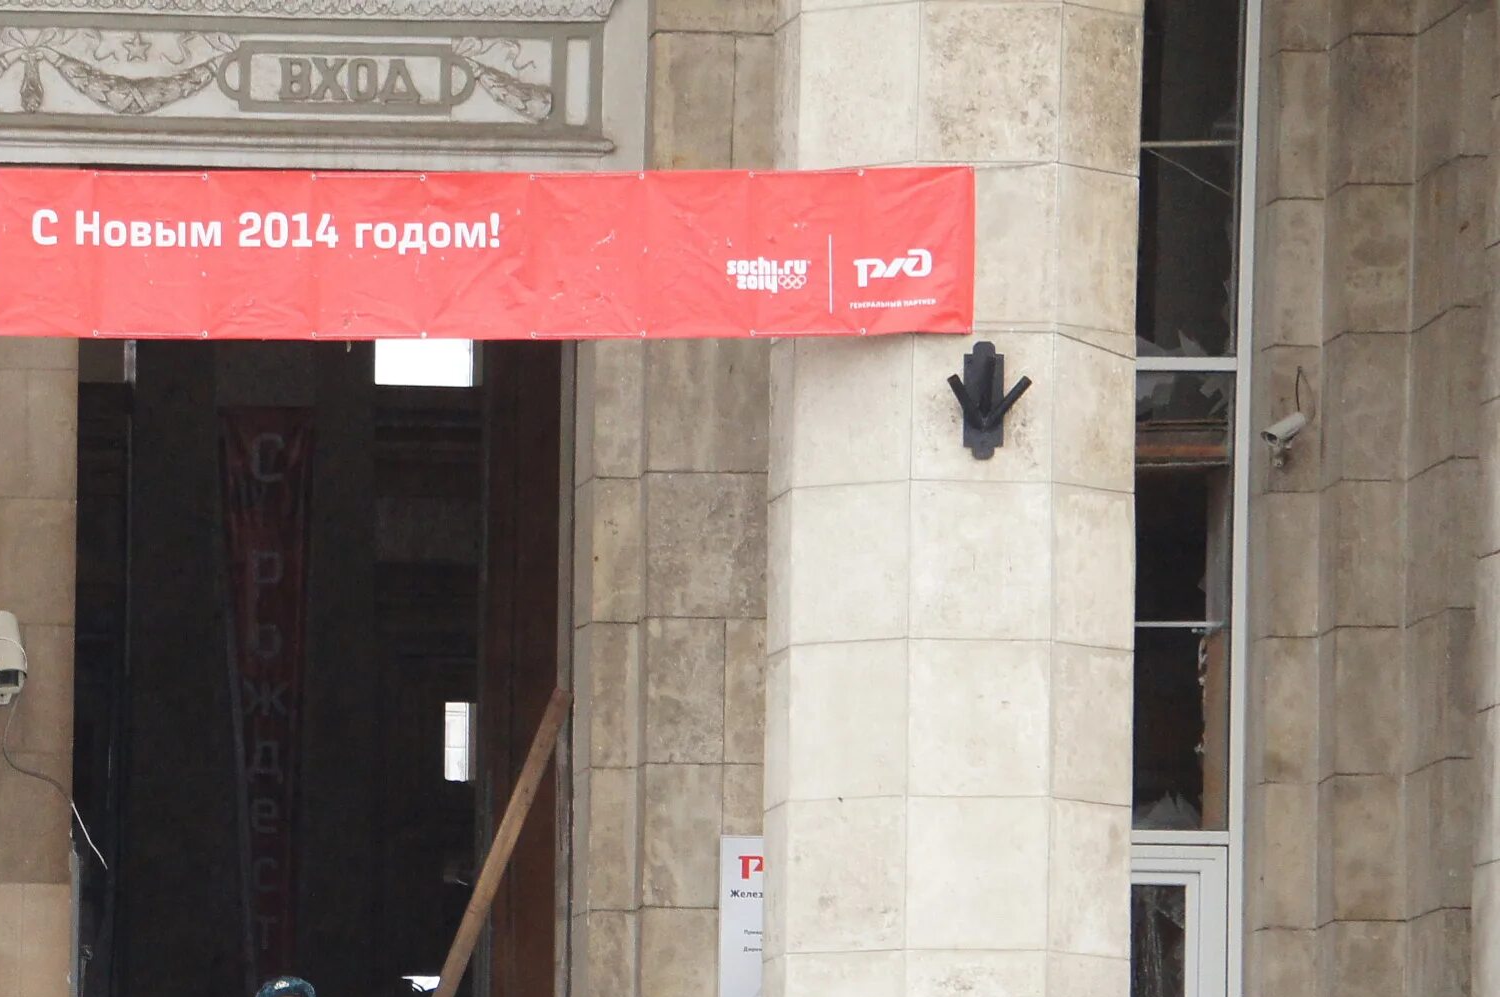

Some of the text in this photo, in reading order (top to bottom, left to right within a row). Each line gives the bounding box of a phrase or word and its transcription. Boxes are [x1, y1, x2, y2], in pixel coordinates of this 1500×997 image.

[279, 57, 421, 104] ВХОД
[31, 209, 501, 255] С Новым 2014 годом!
[726, 256, 807, 275] sochi.ru
[736, 274, 778, 294] 2014
[730, 888, 764, 899] Желез
